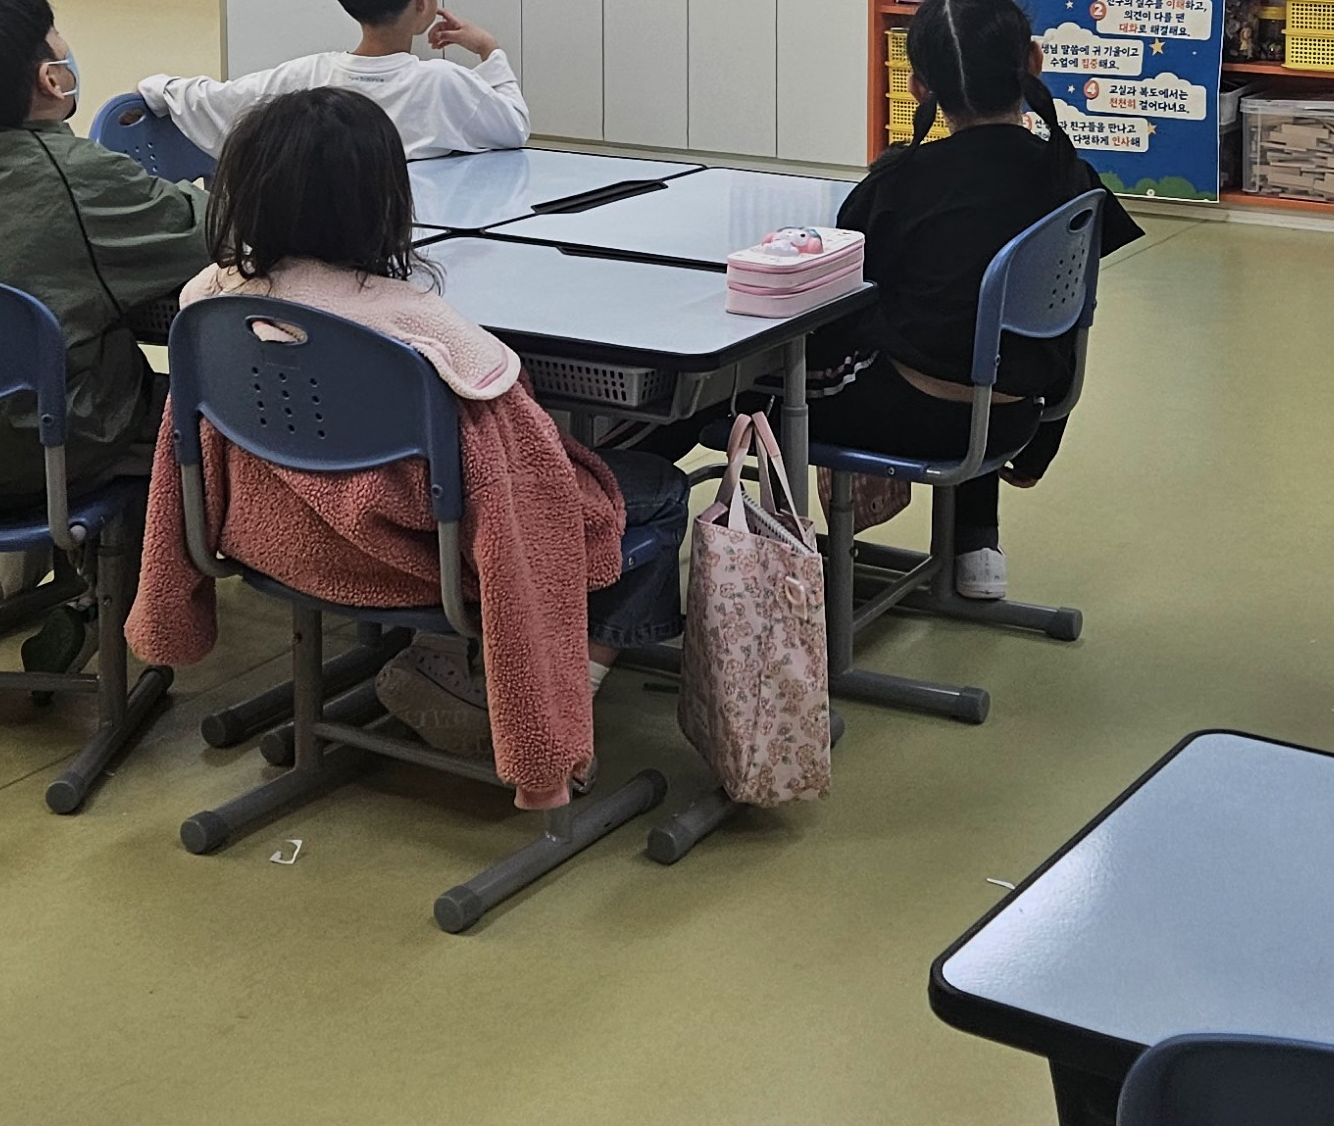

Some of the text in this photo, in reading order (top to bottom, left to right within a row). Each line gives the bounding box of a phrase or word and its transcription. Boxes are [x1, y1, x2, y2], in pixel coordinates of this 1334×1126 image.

[1124, 10, 1151, 21] 의견이
[1154, 12, 1172, 23] 다를
[1119, 23, 1147, 33] 대화로
[1061, 44, 1089, 55] 말씀에
[1092, 46, 1101, 56] 귀
[1104, 46, 1139, 57] 기울이고
[1051, 57, 1078, 68] 수업에
[1109, 85, 1188, 100] 교실과 복도에서는
[1110, 98, 1136, 109] 천천히
[1070, 121, 1105, 132] 친구들을
[1108, 123, 1136, 133] 만나고
[1073, 134, 1140, 147] 다정하게 인사해
